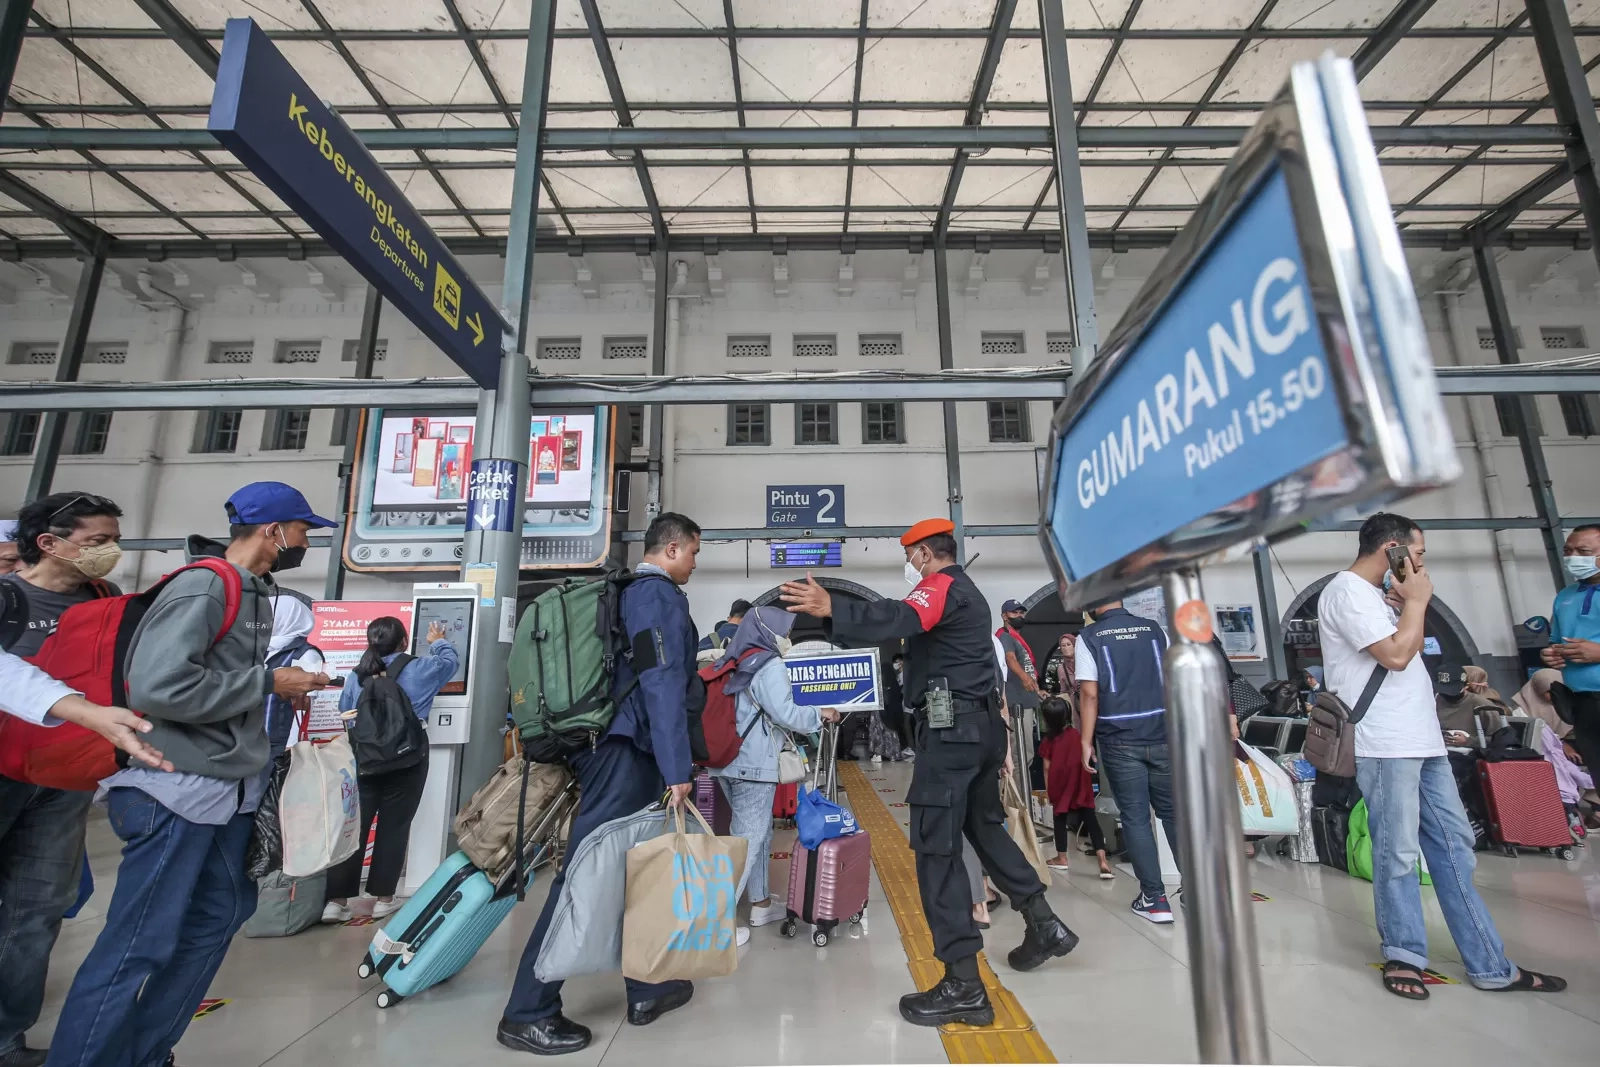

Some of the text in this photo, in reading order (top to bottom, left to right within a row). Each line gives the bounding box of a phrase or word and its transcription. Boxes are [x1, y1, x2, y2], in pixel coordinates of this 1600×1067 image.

[288, 92, 428, 269] Keberangkatan
[370, 226, 425, 292] Departures
[1077, 257, 1310, 509] GUMARANG
[1183, 355, 1325, 478] Pukul 15.50
[470, 470, 514, 485] Cetak
[470, 486, 510, 501] Tiket
[771, 488, 836, 523] Pintu 2
[771, 511, 797, 523] Gate
[323, 619, 360, 628] SYARAT
[1096, 628, 1127, 637] CUSTOMER
[816, 661, 871, 680] PENGANTAR
[800, 681, 857, 693] PASSENGER ONLY
[671, 851, 735, 881] McD
[671, 880, 736, 922] on
[666, 919, 734, 953] ald's
